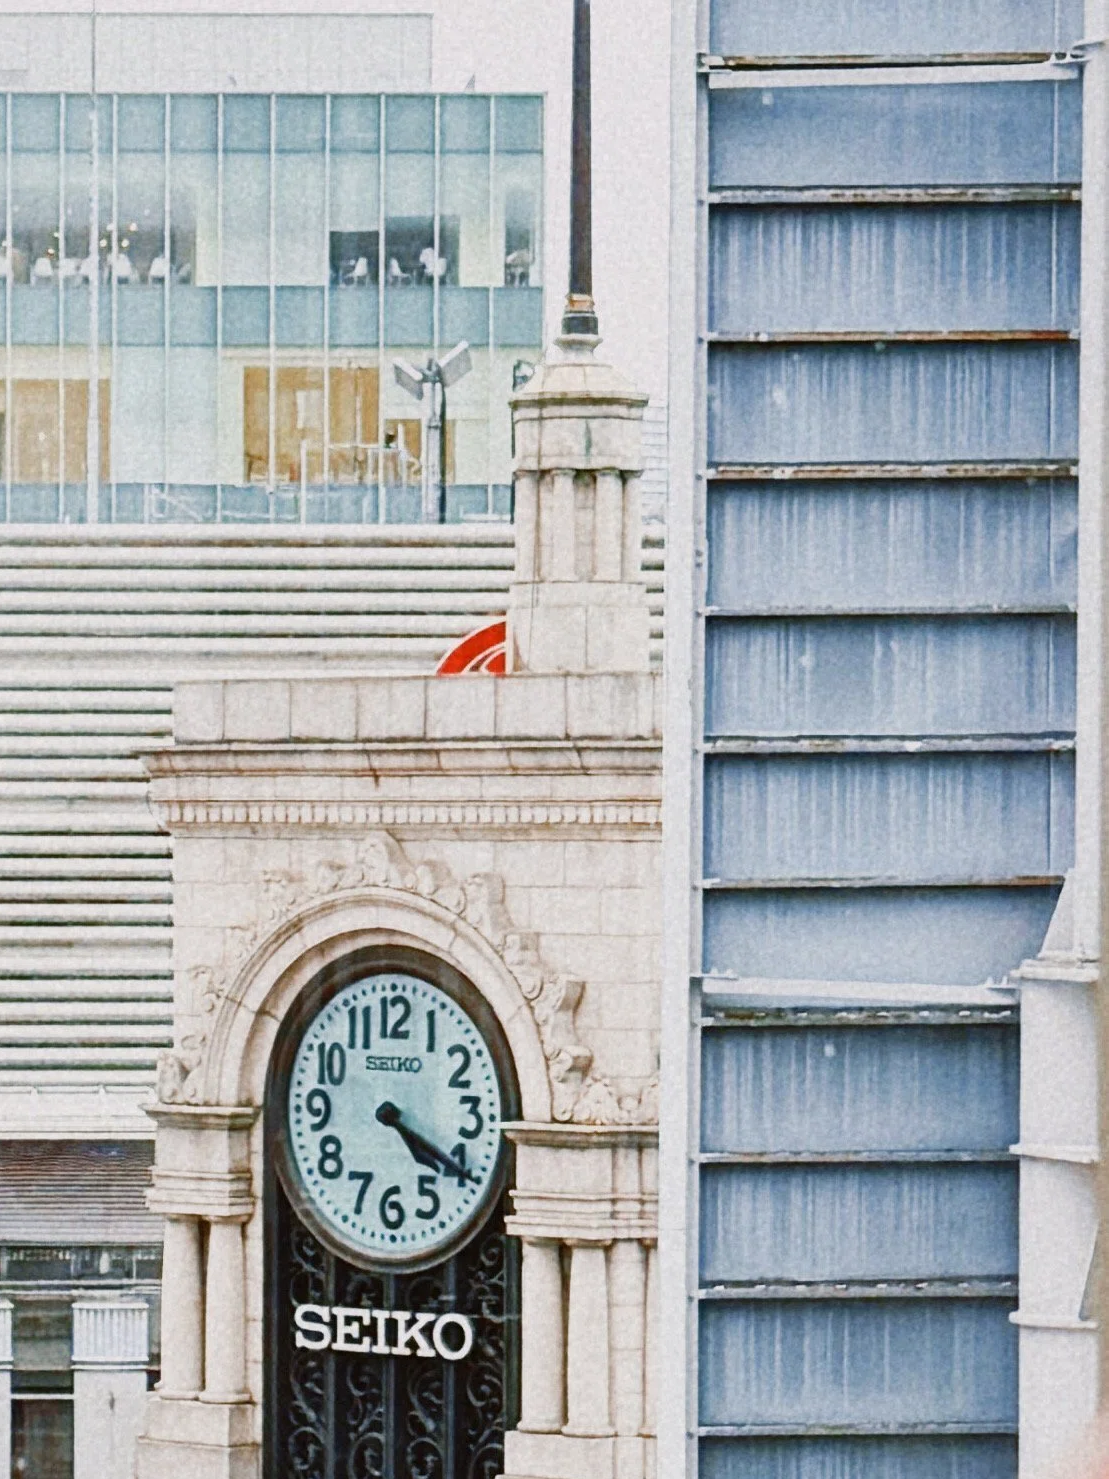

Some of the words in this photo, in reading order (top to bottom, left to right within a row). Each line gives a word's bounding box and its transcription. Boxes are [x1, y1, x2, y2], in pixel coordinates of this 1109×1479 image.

[348, 1005, 372, 1050] 11
[380, 995, 411, 1040] 12
[426, 1009, 436, 1053] 1
[317, 1042, 346, 1086] 10
[365, 1055, 422, 1073] SEIKO
[447, 1044, 472, 1089] 2
[306, 1088, 332, 1132] 9
[459, 1095, 483, 1139] 3
[317, 1135, 343, 1180] 8
[348, 1171, 374, 1215] 7
[379, 1185, 406, 1230] 6
[415, 1175, 440, 1220] 5
[294, 1305, 474, 1360] SEIKO
